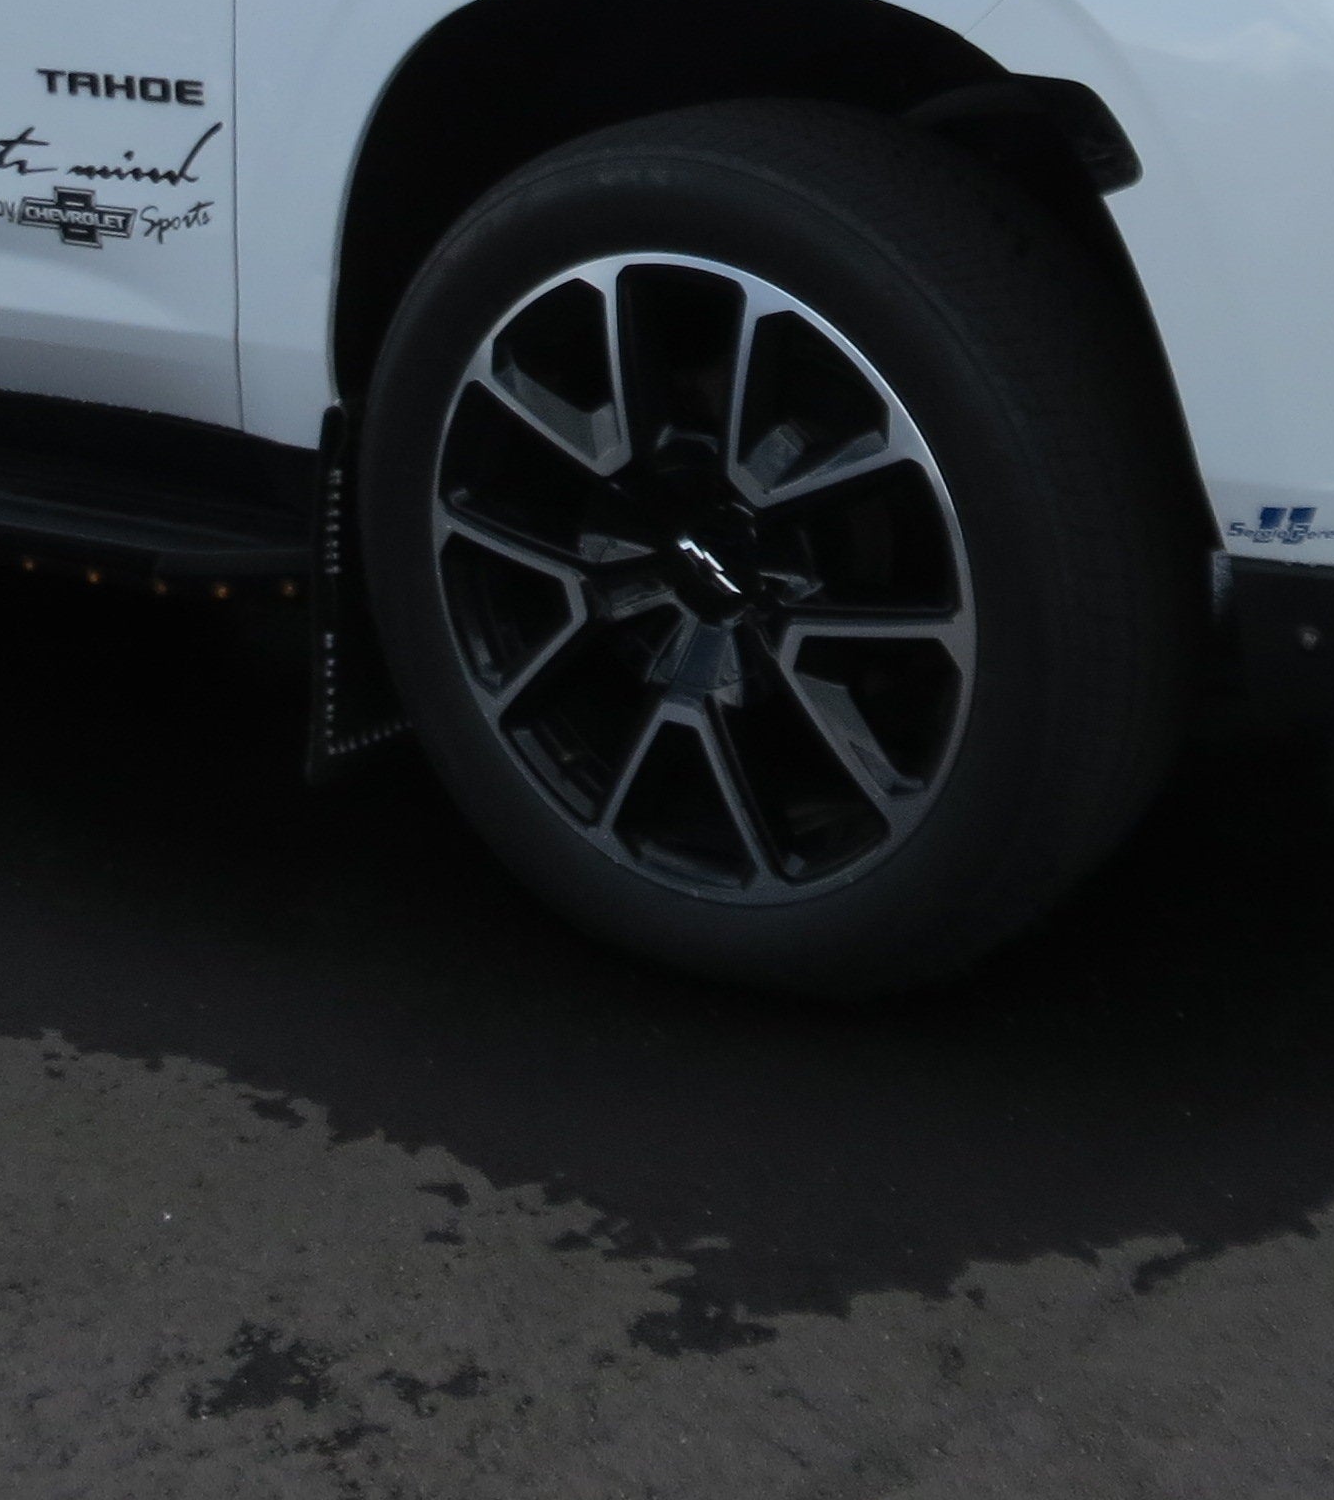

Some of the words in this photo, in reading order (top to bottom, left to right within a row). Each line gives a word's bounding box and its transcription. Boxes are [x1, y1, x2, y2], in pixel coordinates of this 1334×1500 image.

[37, 68, 204, 106] TAHOE
[25, 206, 127, 230] CHEVROLET
[140, 201, 214, 243] Sports
